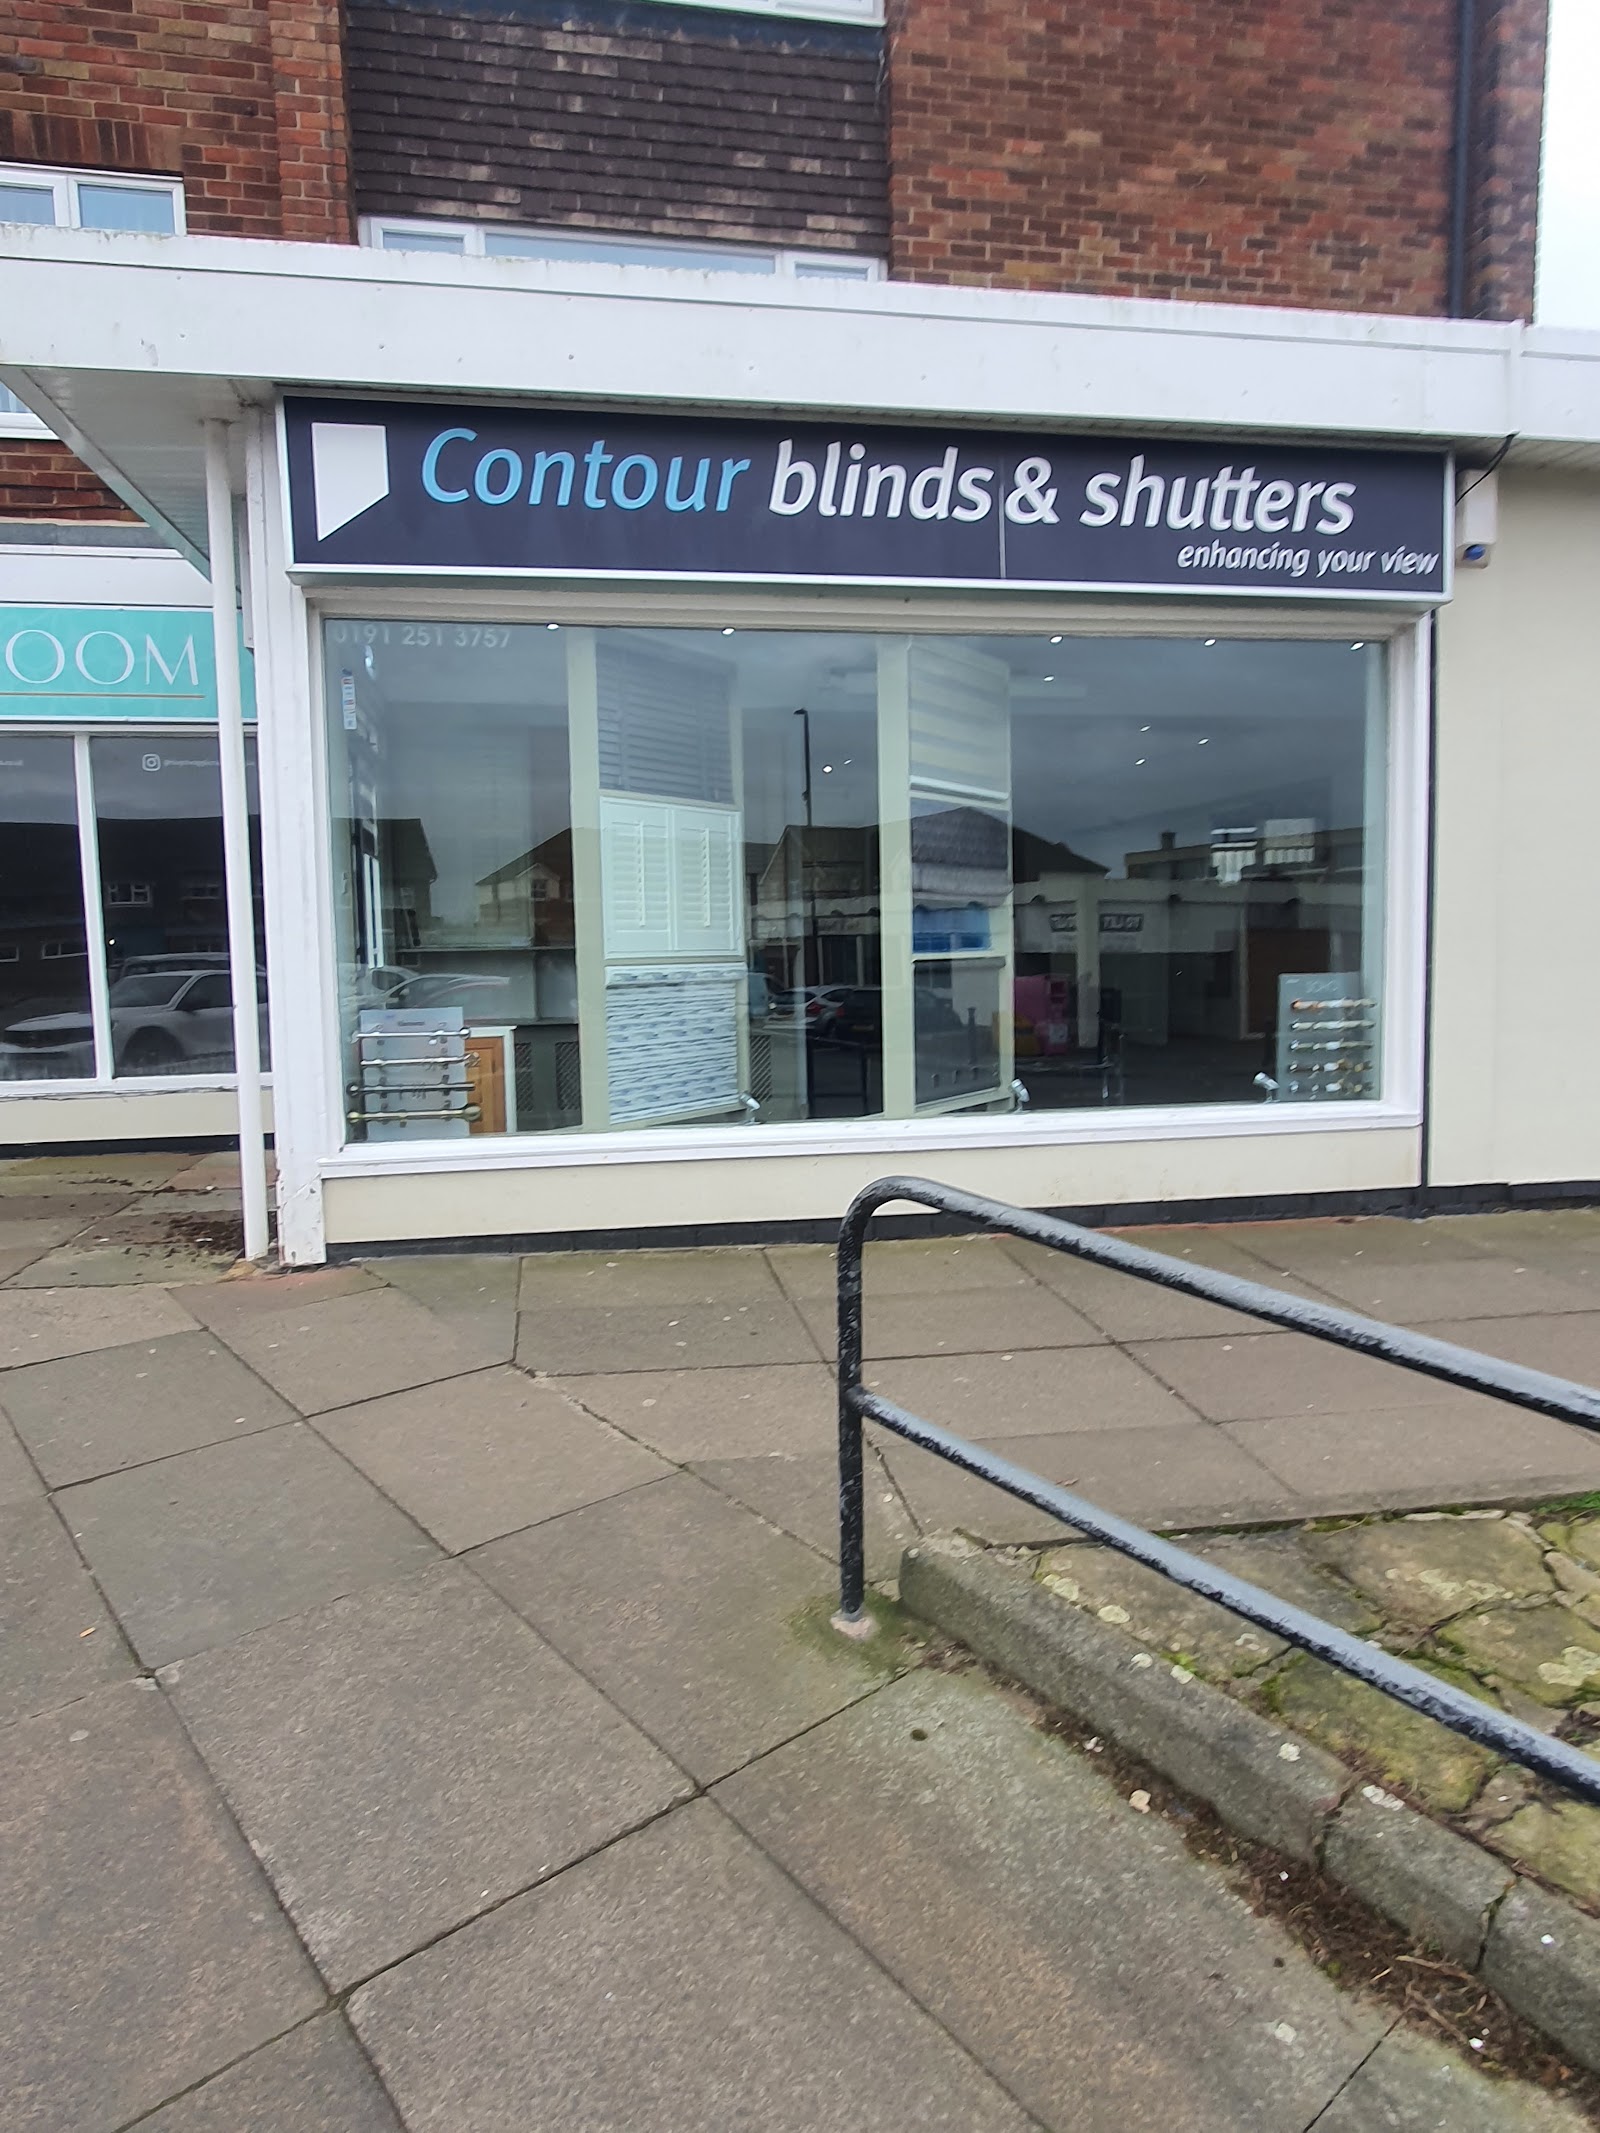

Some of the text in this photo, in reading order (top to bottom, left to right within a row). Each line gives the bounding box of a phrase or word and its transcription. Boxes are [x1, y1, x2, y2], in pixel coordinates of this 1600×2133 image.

[421, 427, 1357, 536] Contour blinds & shutters
[1177, 539, 1440, 578] enhancing your view
[5, 629, 199, 686] OOM
[333, 624, 512, 648] 0191 251 3757
